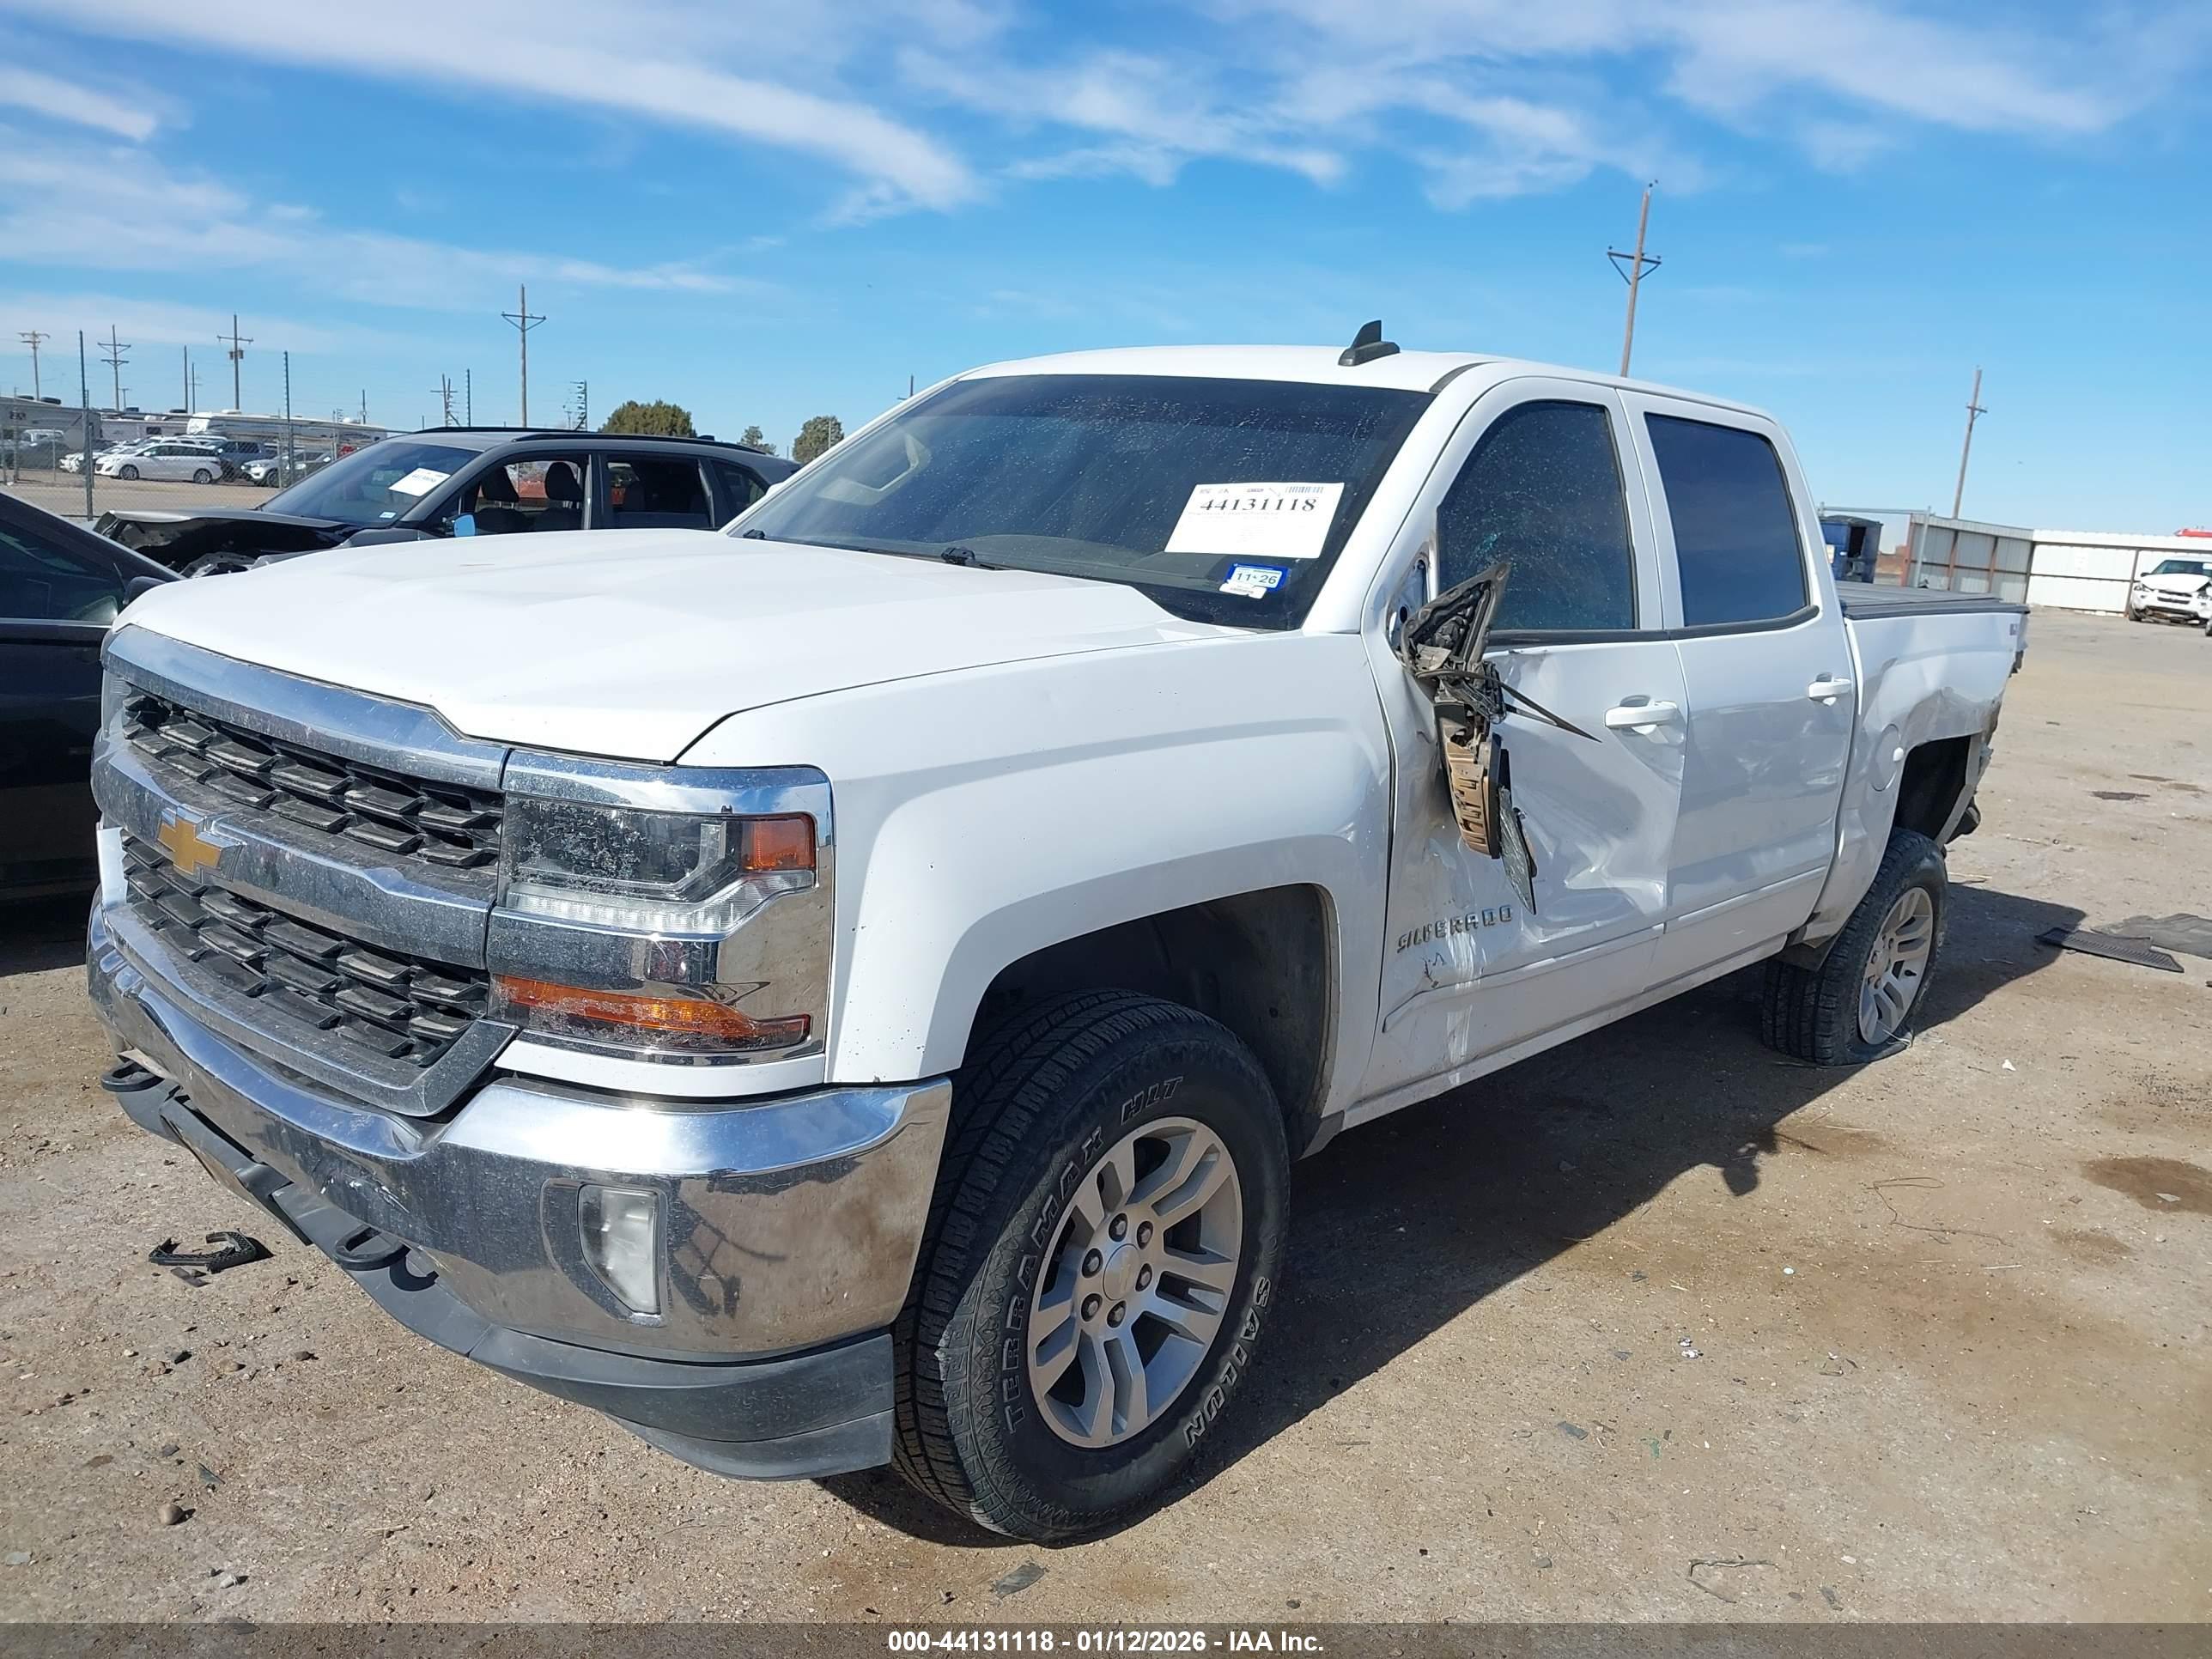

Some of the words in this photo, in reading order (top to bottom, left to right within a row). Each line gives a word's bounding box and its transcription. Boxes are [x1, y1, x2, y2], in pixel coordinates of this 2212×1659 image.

[1200, 498, 1317, 512] 44131118
[1396, 904, 1513, 953] SILVERADO
[1183, 1276, 1271, 1449] SAILUN
